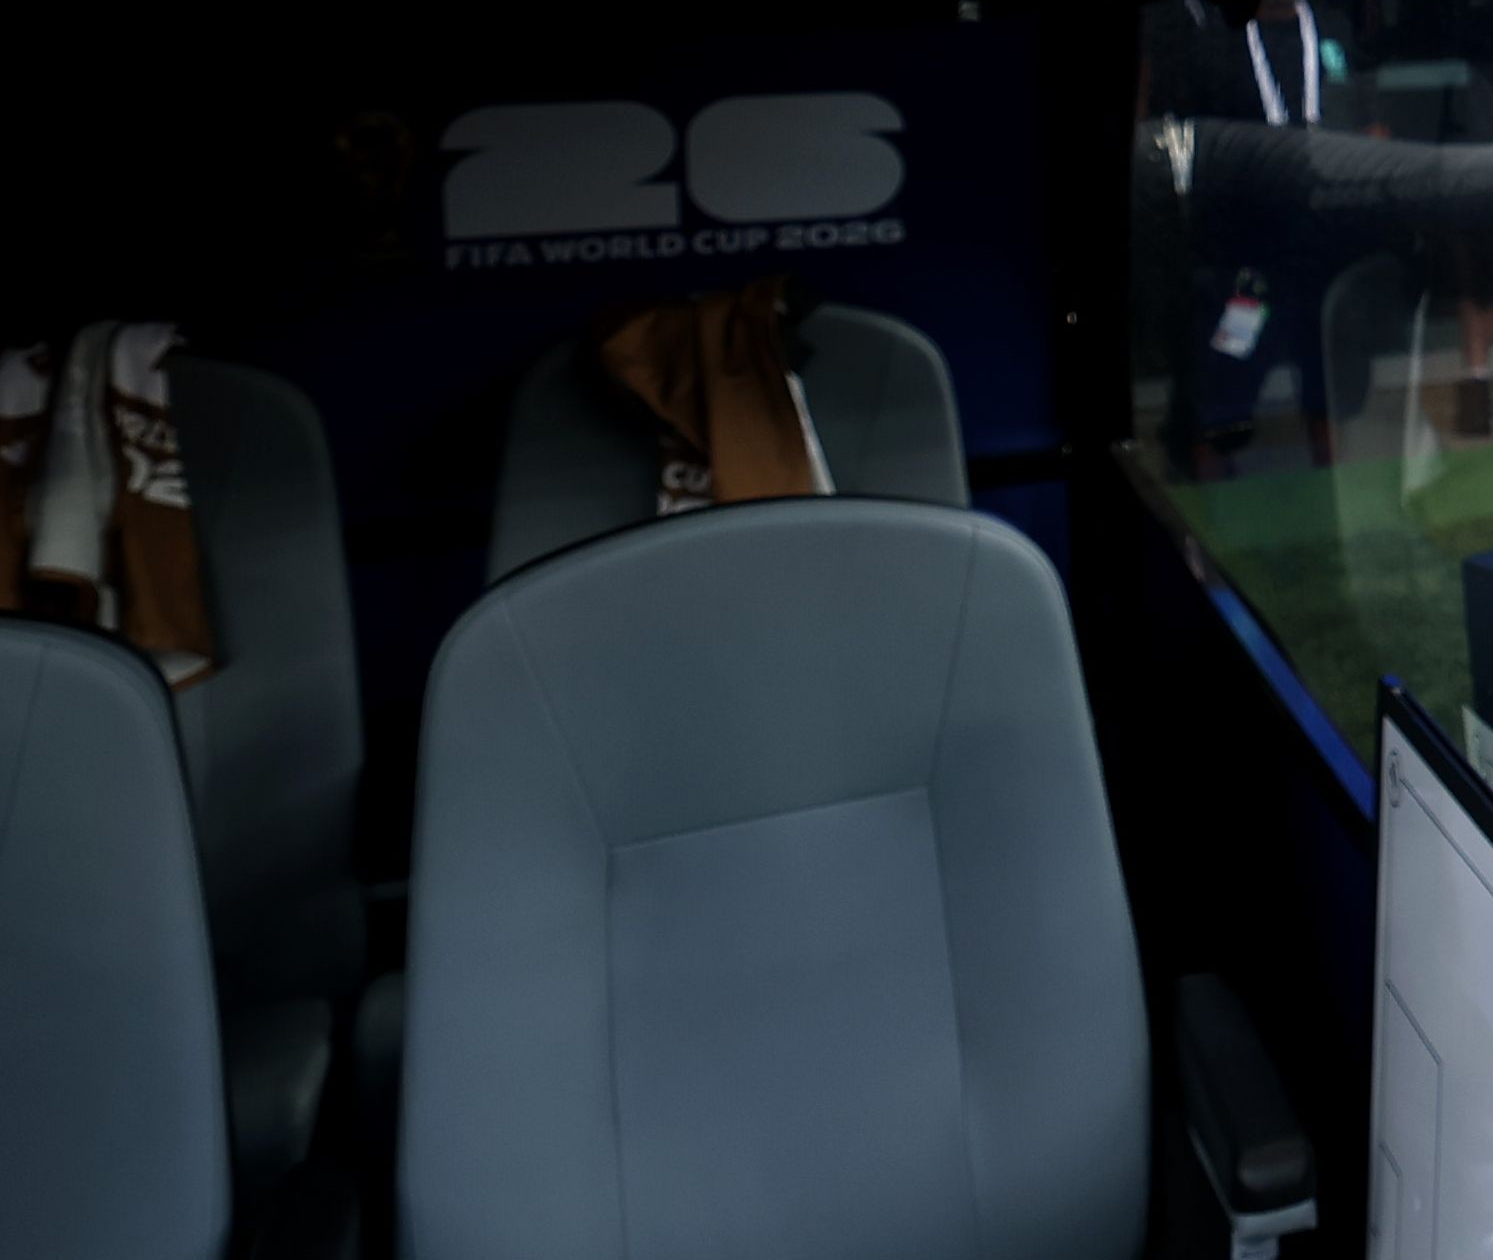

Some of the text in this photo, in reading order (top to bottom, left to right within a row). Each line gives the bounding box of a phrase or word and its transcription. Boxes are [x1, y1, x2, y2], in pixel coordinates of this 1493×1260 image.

[441, 92, 905, 238] 26
[446, 219, 903, 269] FIFA WORLD CUP 2026
